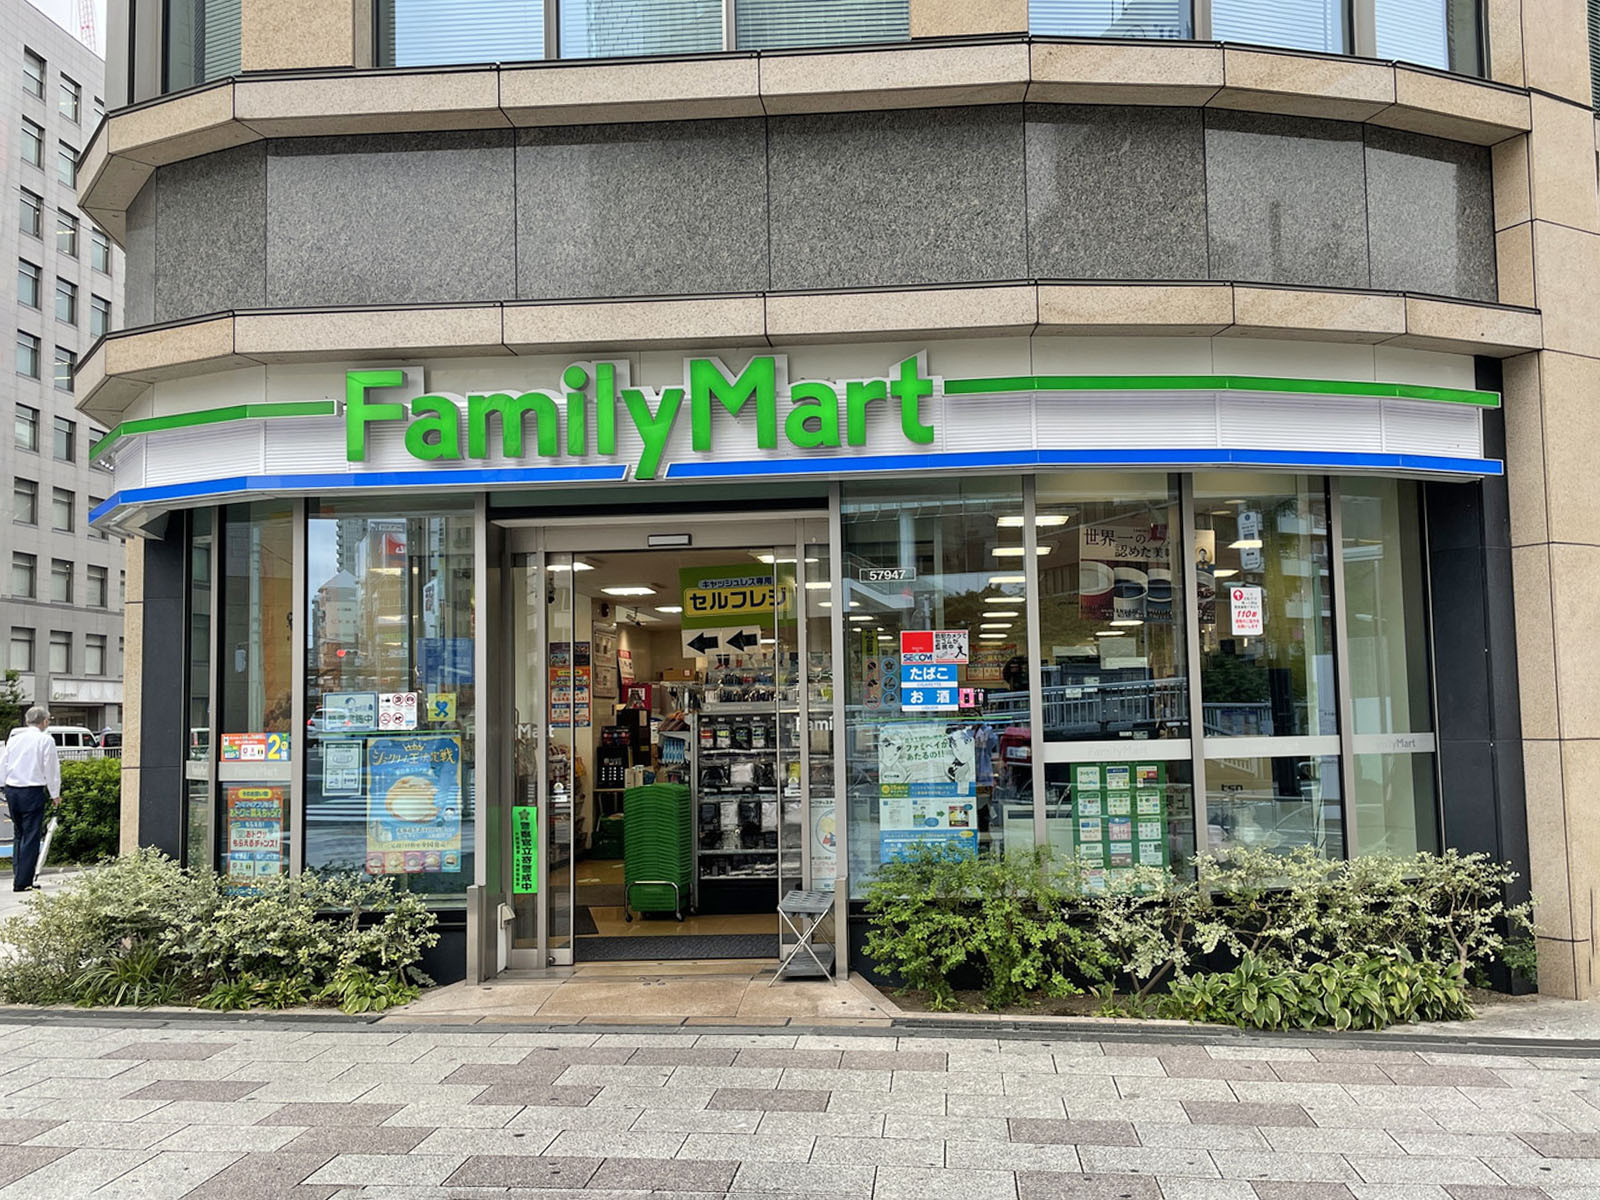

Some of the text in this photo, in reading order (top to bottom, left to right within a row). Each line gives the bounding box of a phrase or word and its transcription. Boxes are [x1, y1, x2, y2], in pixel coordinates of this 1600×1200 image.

[346, 356, 934, 480] FamilyMart
[869, 570, 906, 581] 57947
[689, 588, 787, 611] セルフレジ
[903, 653, 933, 662] SECOM
[910, 667, 949, 680] たばこ
